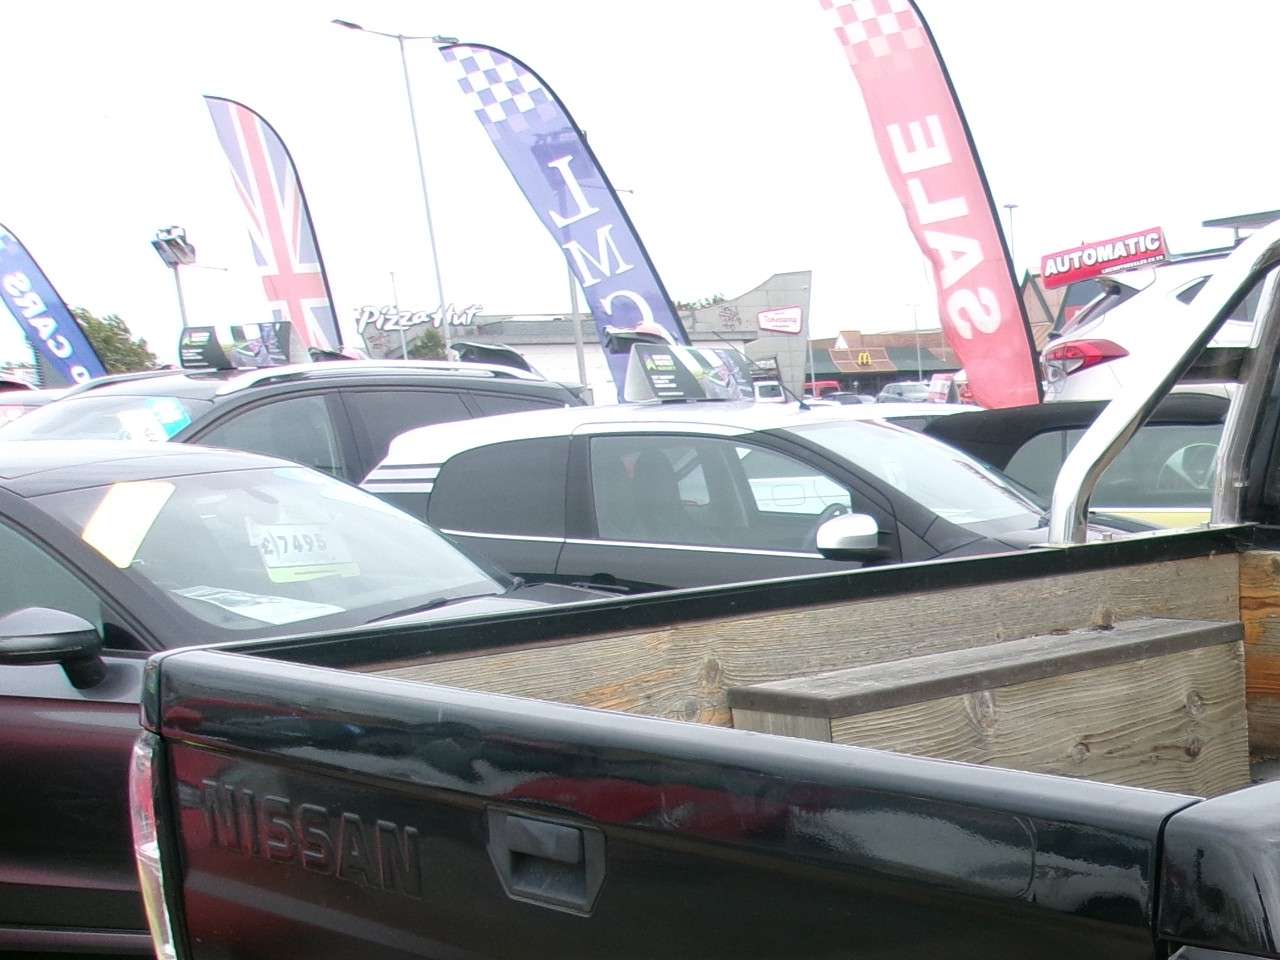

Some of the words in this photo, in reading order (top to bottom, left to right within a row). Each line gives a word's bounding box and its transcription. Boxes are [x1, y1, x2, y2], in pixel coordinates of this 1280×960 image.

[1044, 232, 1161, 278] AUTOMATIC
[356, 304, 432, 335] Pizza
[201, 779, 424, 899] NISSAN
